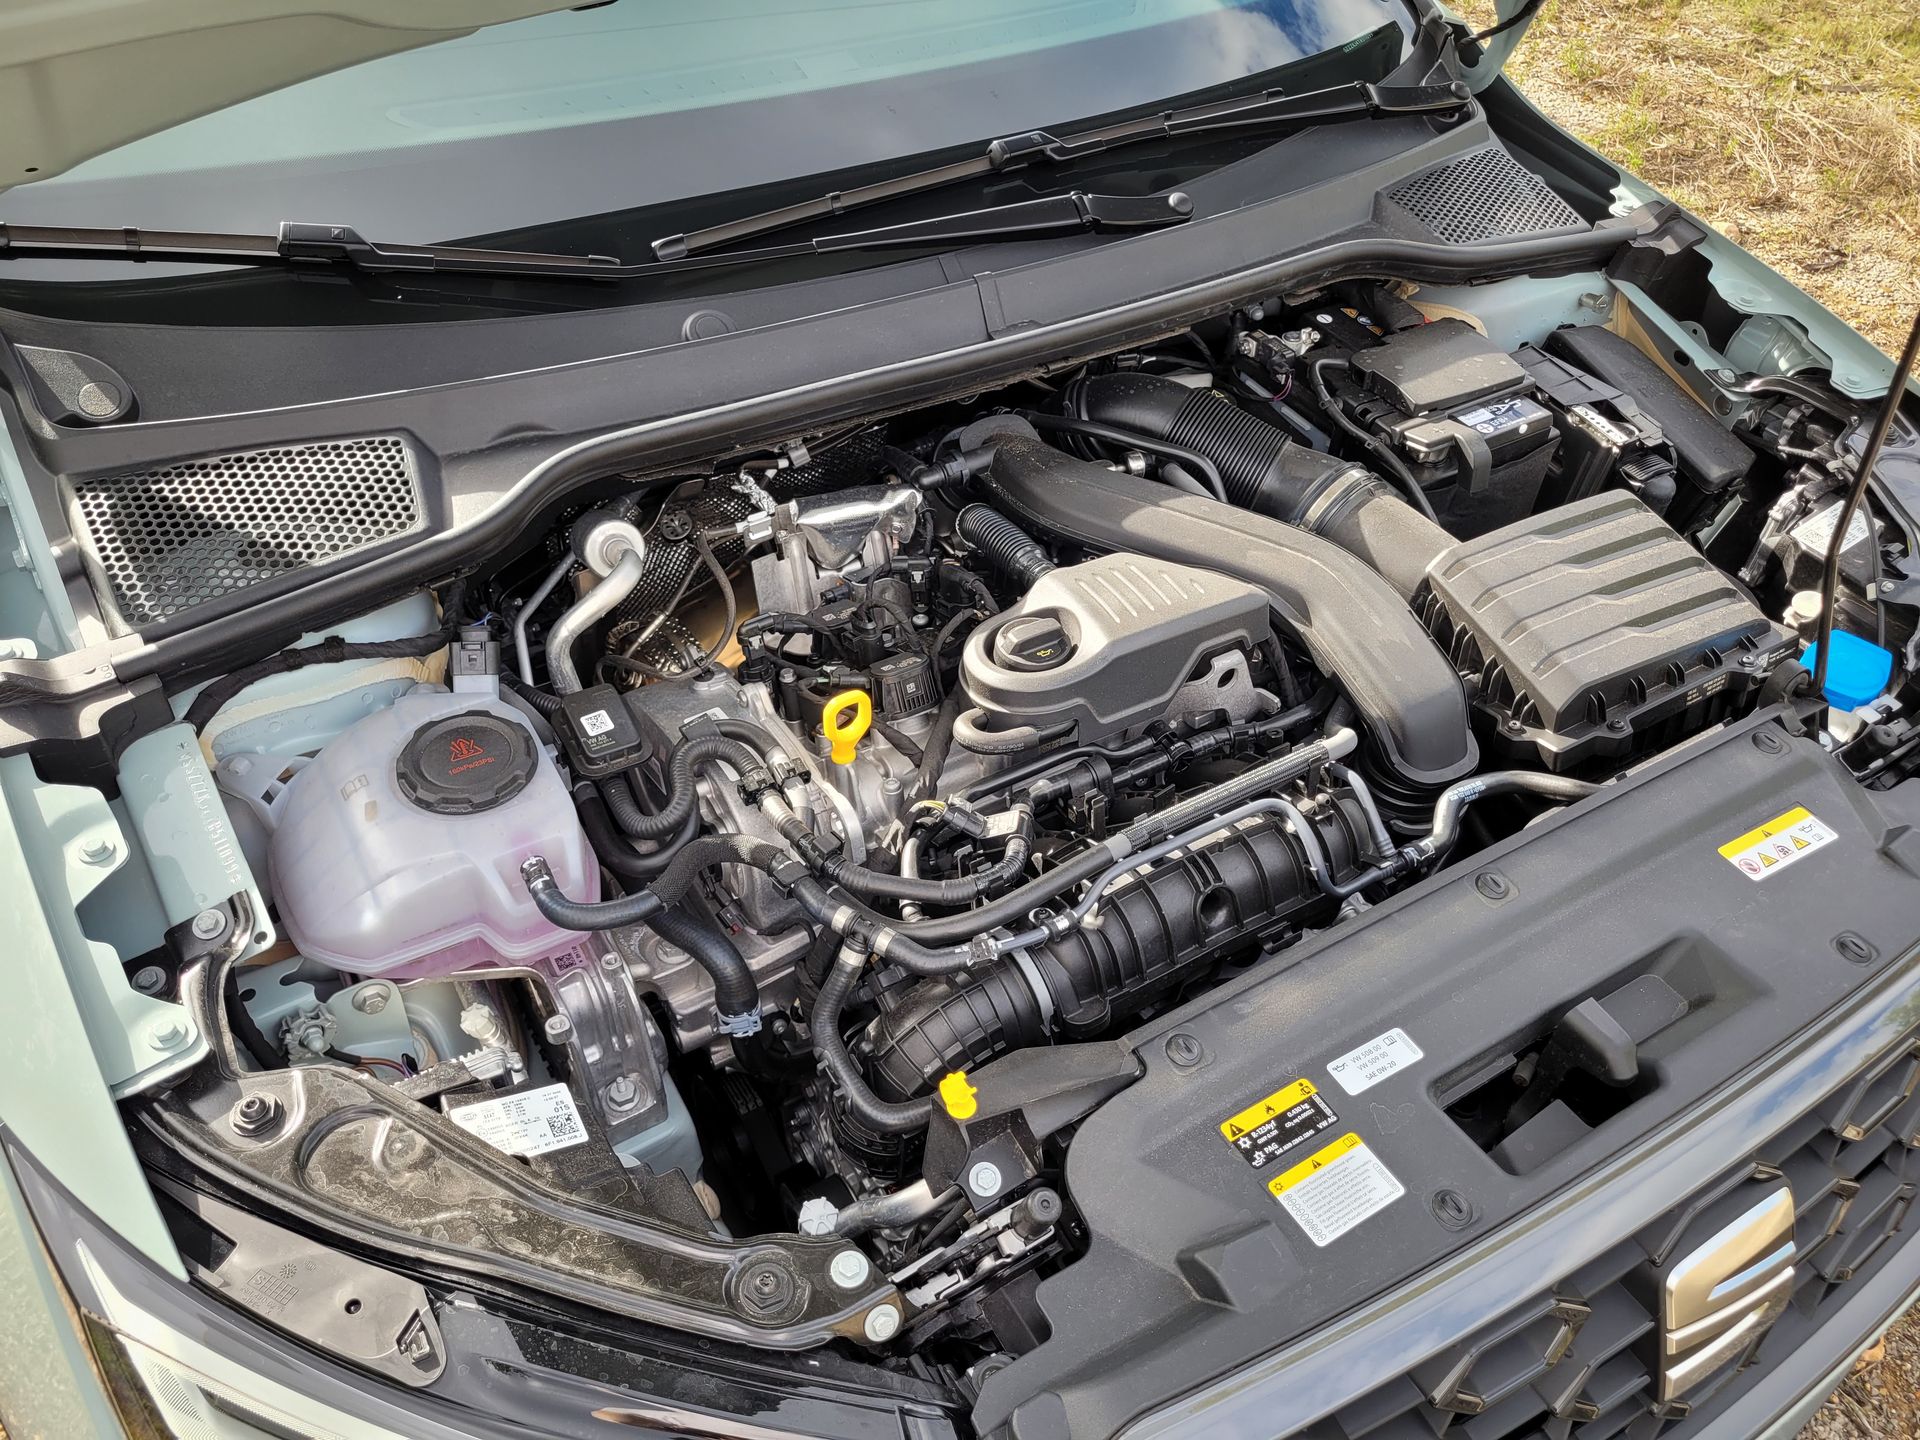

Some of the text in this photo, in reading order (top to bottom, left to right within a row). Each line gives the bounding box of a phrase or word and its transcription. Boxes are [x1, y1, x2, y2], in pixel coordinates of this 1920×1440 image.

[1350, 1044, 1382, 1064] VW 508 00
[1357, 1051, 1389, 1071] VW 509 00
[1365, 1060, 1397, 1081] SAE 0W-20
[553, 1104, 571, 1114] 01S
[1250, 1120, 1278, 1139] R-1234yf
[1300, 1102, 1310, 1111] kg
[1317, 1120, 1329, 1130] VW
[1327, 1115, 1337, 1123] AG
[1263, 1142, 1279, 1154] PAG
